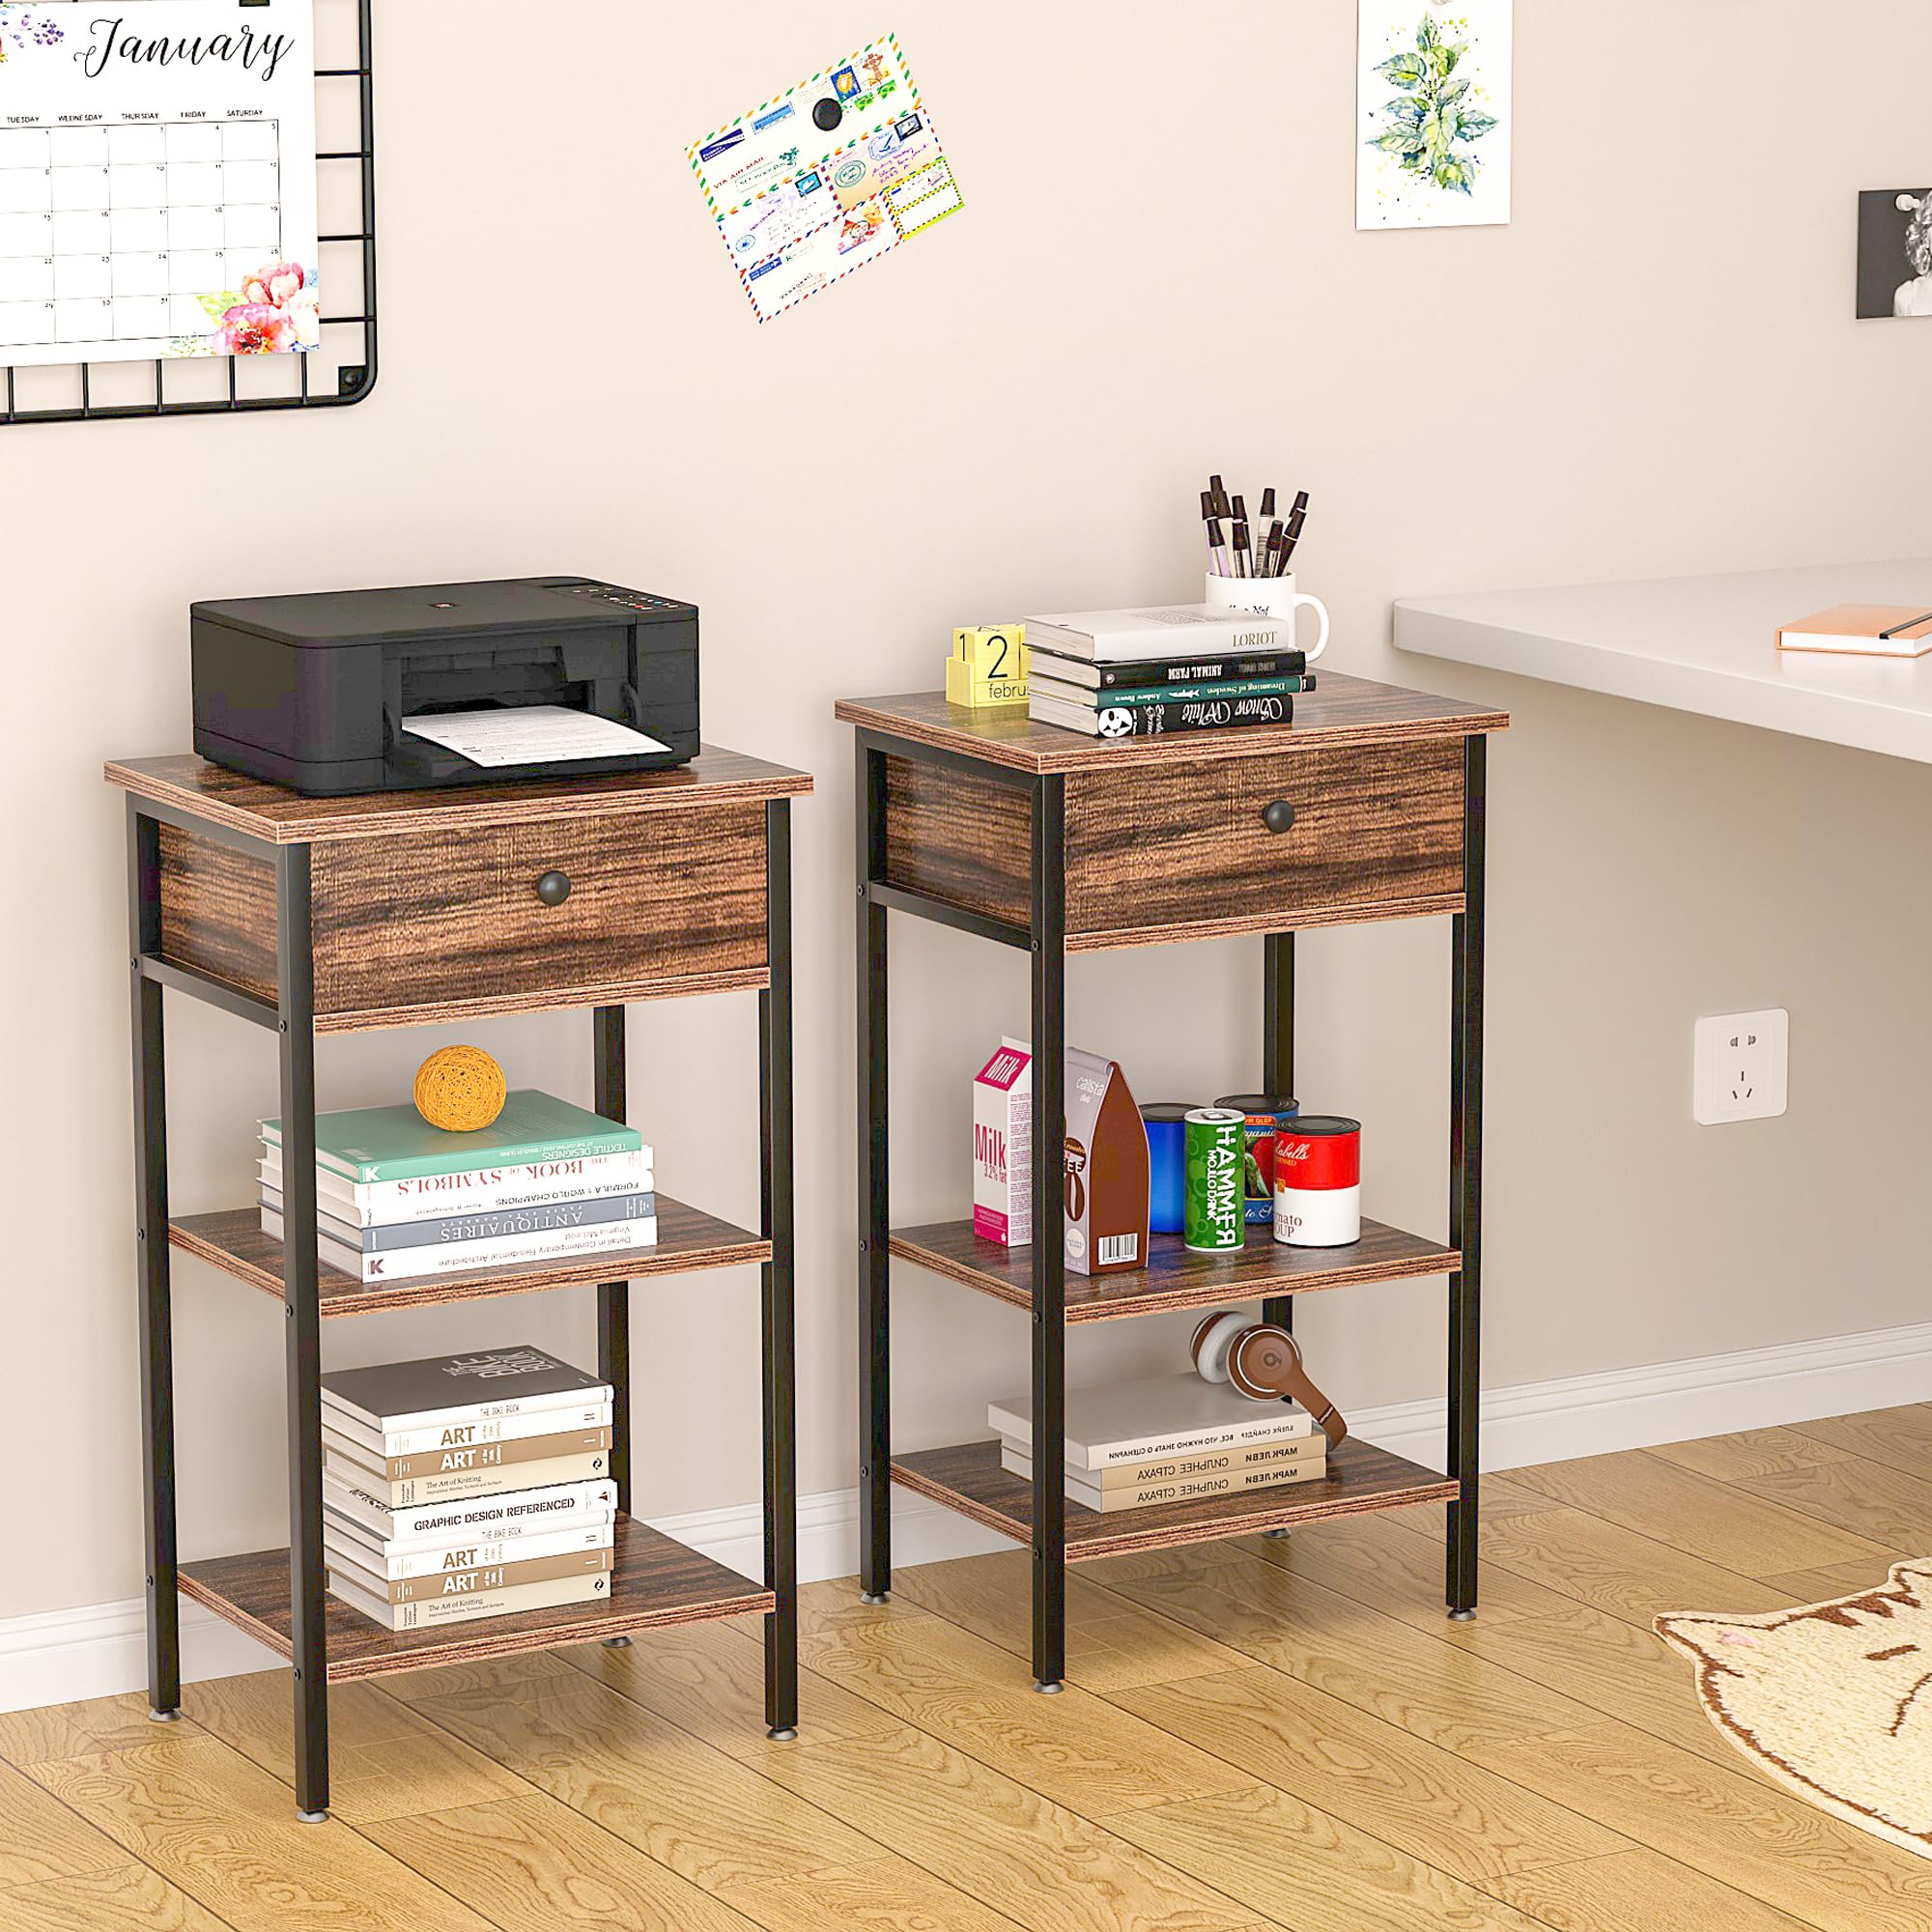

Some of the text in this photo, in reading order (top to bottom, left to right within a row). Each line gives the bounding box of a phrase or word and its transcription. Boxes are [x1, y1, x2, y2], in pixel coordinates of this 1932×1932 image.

[74, 18, 294, 81] January
[58, 114, 103, 122] WEDNESDAY
[1233, 631, 1278, 647] LORIOT
[959, 633, 1008, 679] 1 2
[1168, 665, 1222, 680] ANIMAL FARM
[989, 683, 1029, 698] febru
[1207, 687, 1237, 695] Sweden
[1247, 682, 1285, 692] Dreaming
[1181, 697, 1283, 726] Snow White
[984, 1053, 1020, 1084] Milk
[542, 1143, 627, 1161] TEXTILE DESIGNERS
[975, 1123, 1007, 1170] Milk
[526, 1160, 582, 1179] BOOK
[398, 1169, 502, 1195] SYMBOLS
[595, 1182, 639, 1193] FORMULA
[1216, 1126, 1237, 1245] HAMMER
[496, 1194, 550, 1206] CHAMPIONS
[552, 1188, 585, 1199] WORLD
[440, 1211, 583, 1241] ANTIQUAIRES
[565, 1226, 630, 1240] Virginia McLeod
[1276, 1222, 1295, 1237] OUP
[539, 1241, 596, 1254] Contemporary
[607, 1236, 631, 1246] Detail
[439, 1255, 488, 1266] Architecture
[491, 1247, 536, 1261] Residential
[480, 1404, 520, 1416] THE BIKE BOOK
[440, 1426, 476, 1446] ART
[440, 1449, 477, 1471] ART
[457, 1476, 482, 1485] Knitting
[414, 1515, 462, 1531] GRAPHIC
[465, 1509, 503, 1524] DESIGN
[507, 1498, 575, 1517] REFERENCED
[482, 1527, 521, 1539] THE BIKE BOOK
[443, 1548, 478, 1569] ART
[443, 1572, 479, 1594] ART
[441, 1602, 451, 1610] Art
[460, 1598, 483, 1607] Knitting
